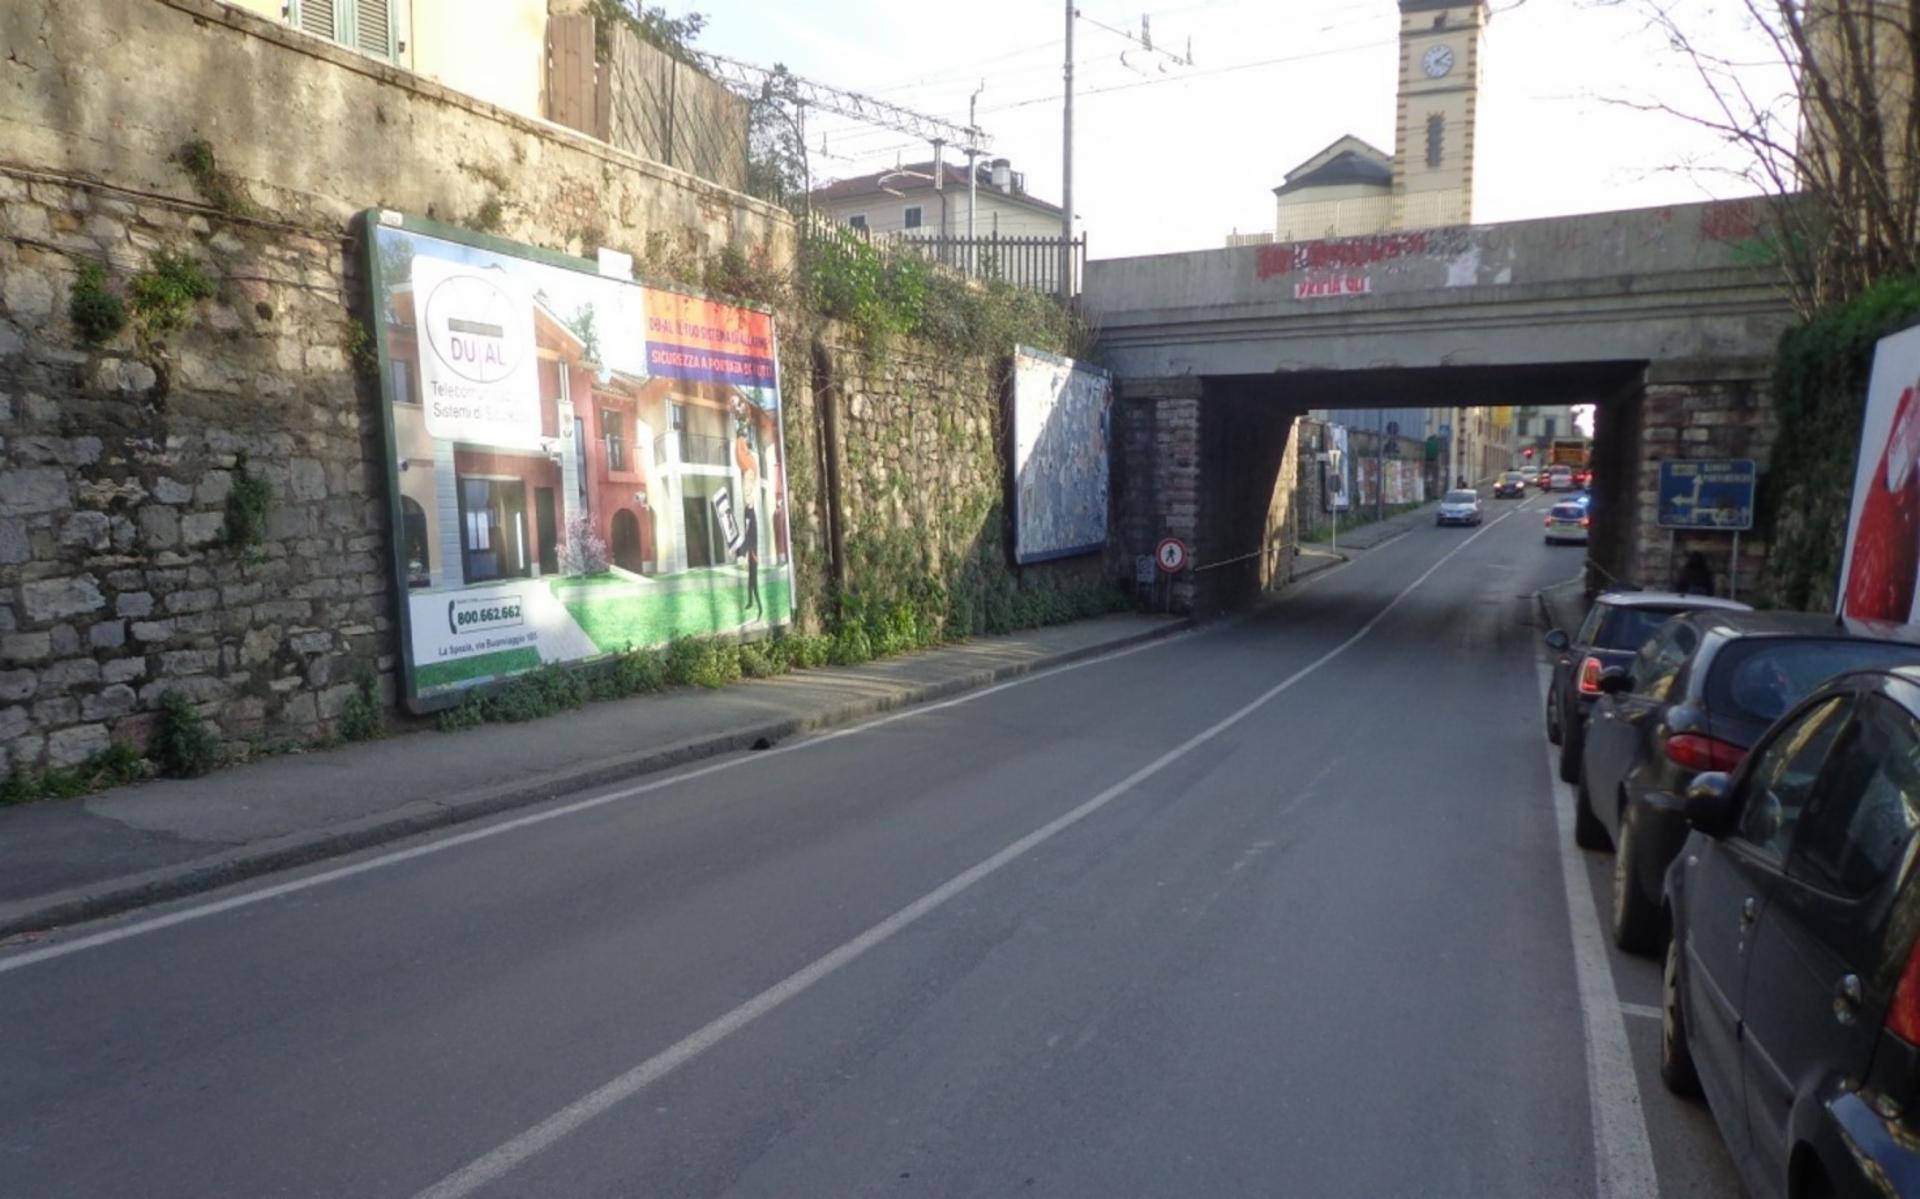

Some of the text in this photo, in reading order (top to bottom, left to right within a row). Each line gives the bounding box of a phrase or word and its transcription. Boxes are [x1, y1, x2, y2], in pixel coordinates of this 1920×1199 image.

[652, 351, 700, 368] SICUREZZA
[458, 606, 520, 625] 800.662.662
[438, 647, 448, 656] La
